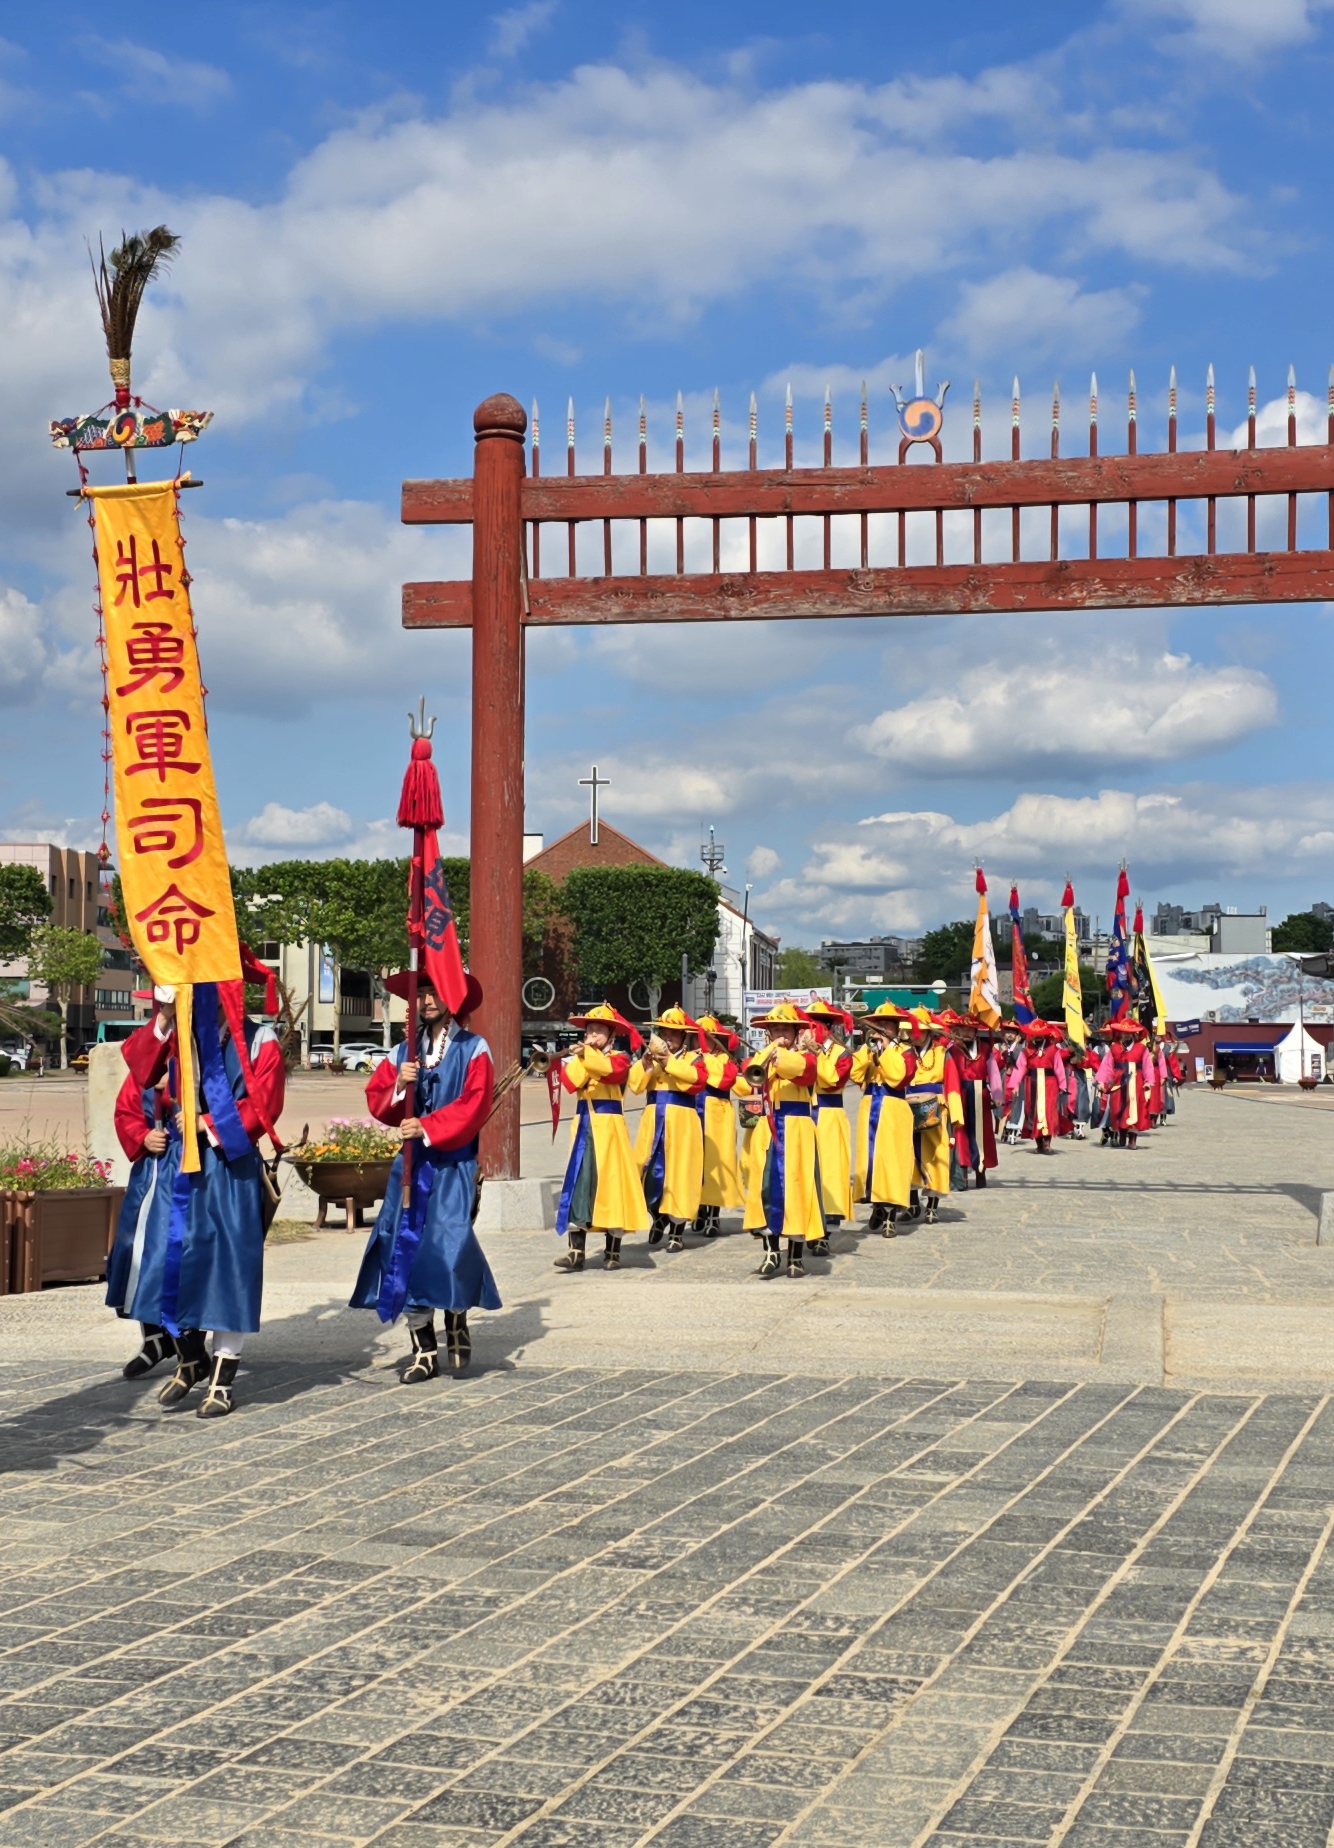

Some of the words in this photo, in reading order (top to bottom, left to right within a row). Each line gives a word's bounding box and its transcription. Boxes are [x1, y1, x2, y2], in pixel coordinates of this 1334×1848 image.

[113, 534, 216, 956] 壯勇軍司命
